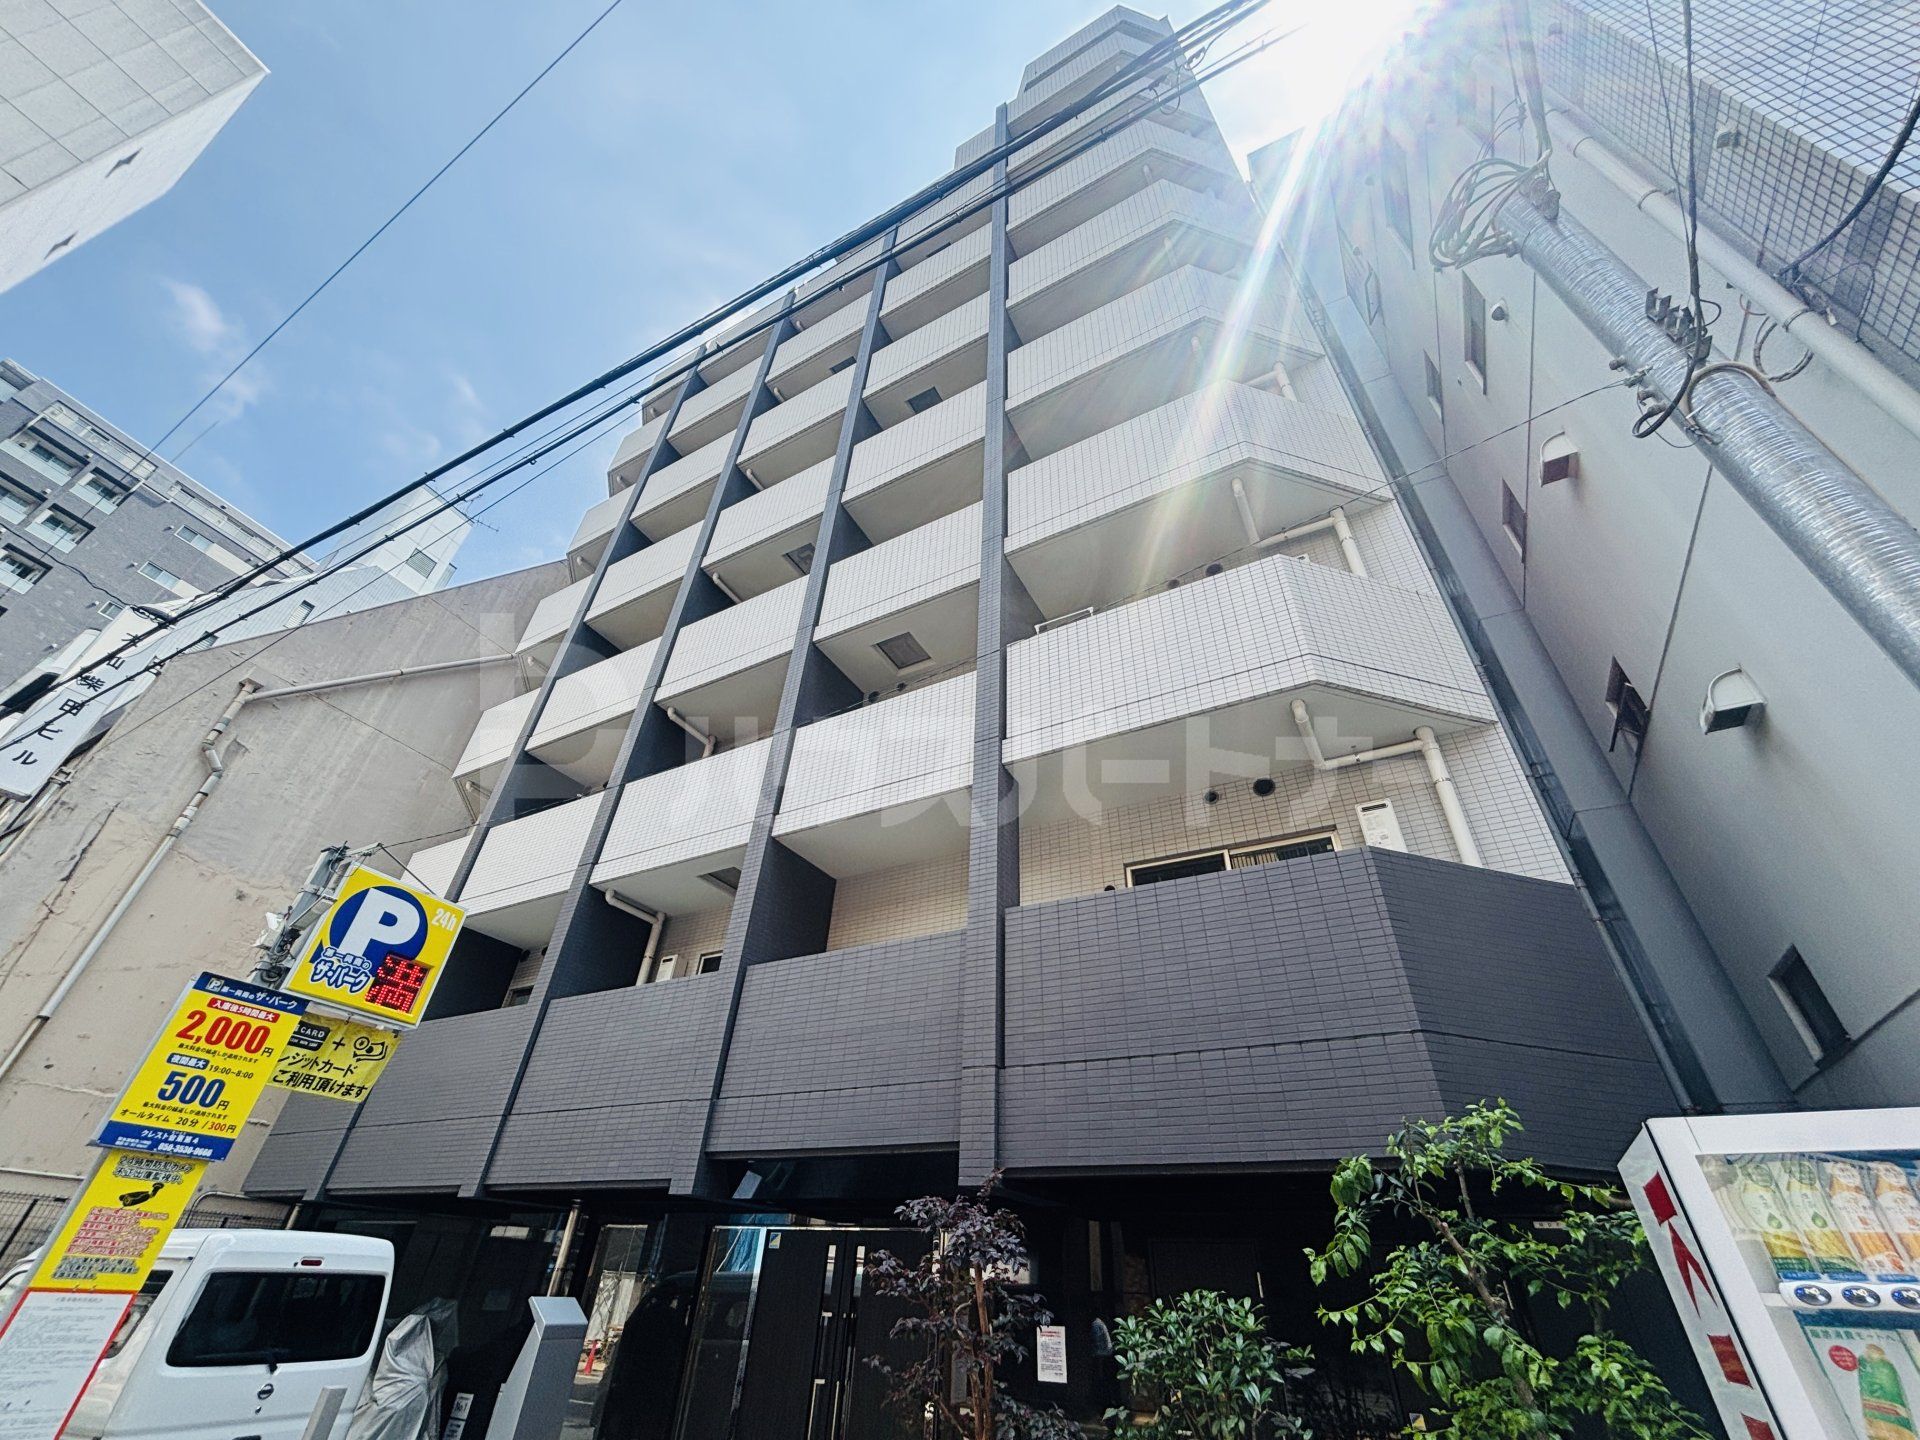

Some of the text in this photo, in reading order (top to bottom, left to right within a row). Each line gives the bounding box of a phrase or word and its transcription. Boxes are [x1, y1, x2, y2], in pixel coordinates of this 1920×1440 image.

[431, 908, 458, 931] 24h
[278, 1052, 357, 1077] ジットカード
[272, 1069, 368, 1098] ご利用頂けます
